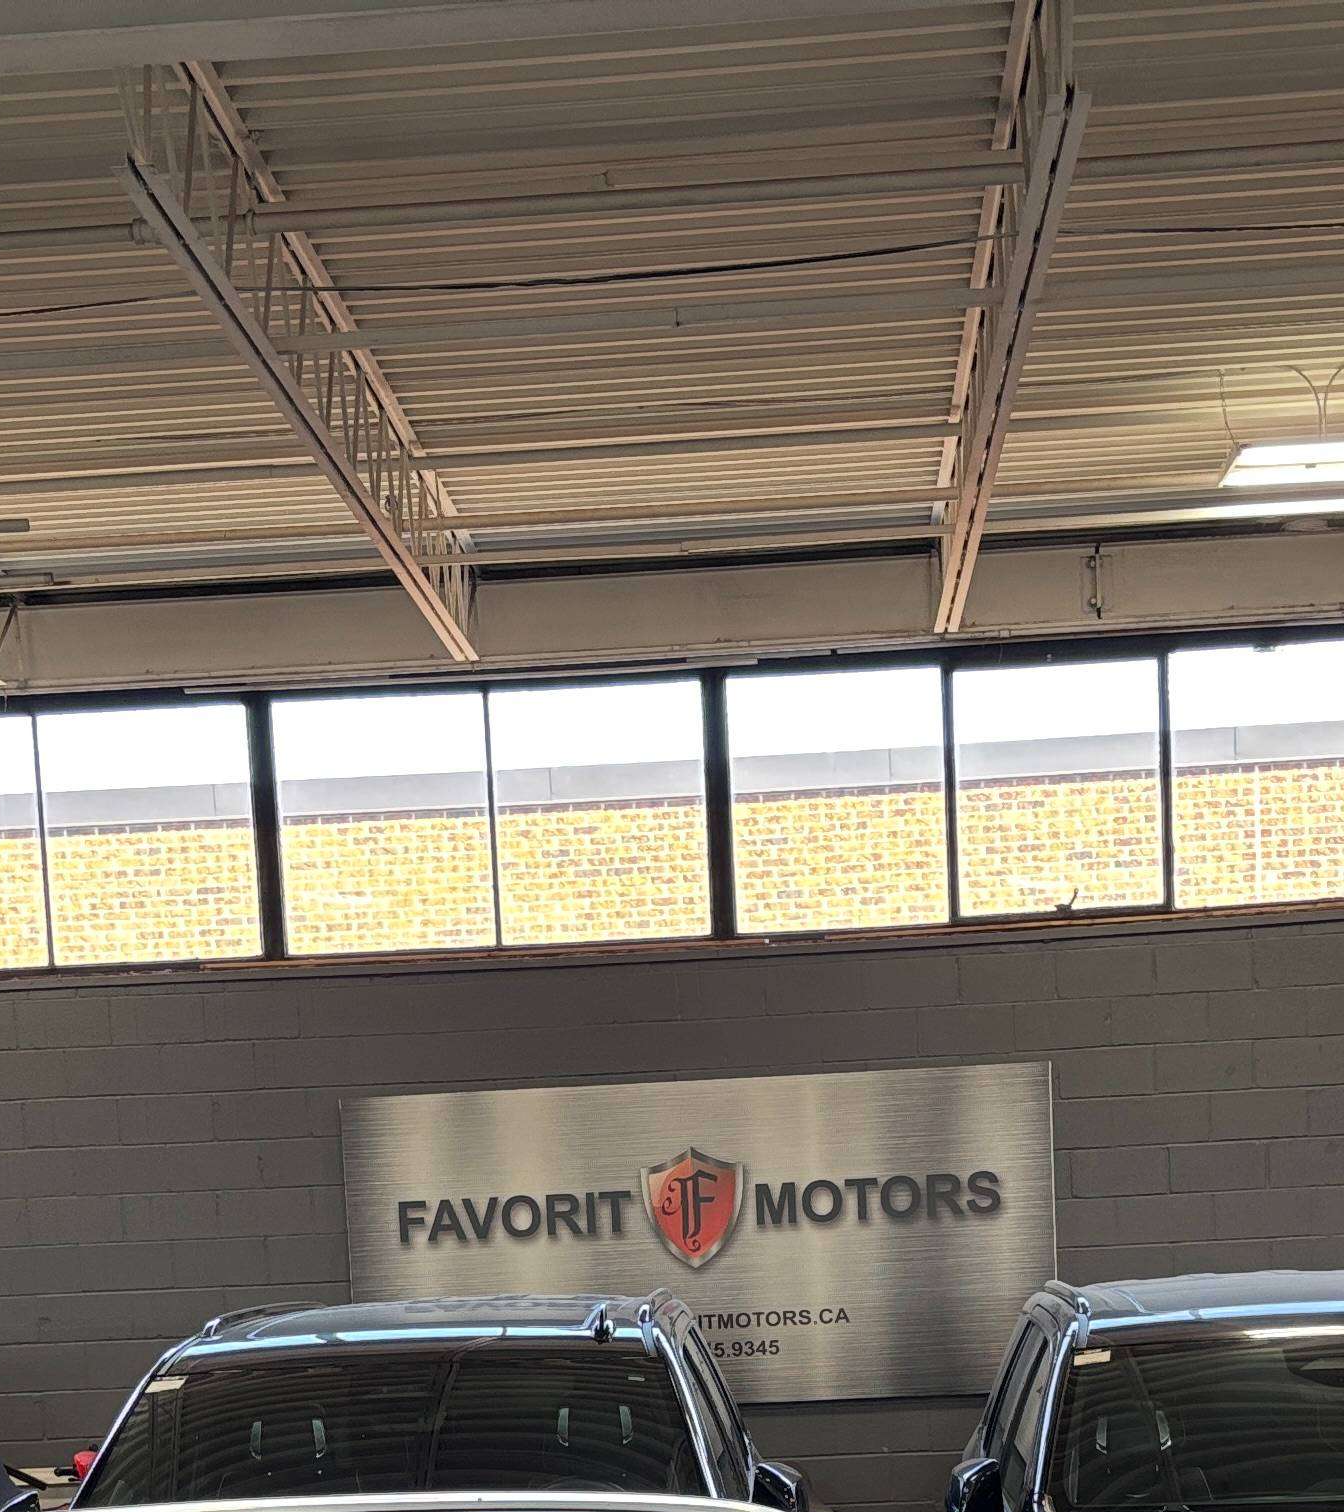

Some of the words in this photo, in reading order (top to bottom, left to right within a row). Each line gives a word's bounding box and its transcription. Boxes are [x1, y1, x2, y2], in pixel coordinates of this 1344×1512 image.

[398, 1190, 631, 1243] FAVORIT
[756, 1170, 1002, 1226] MOTORS
[707, 1339, 780, 1358] 5.9345
